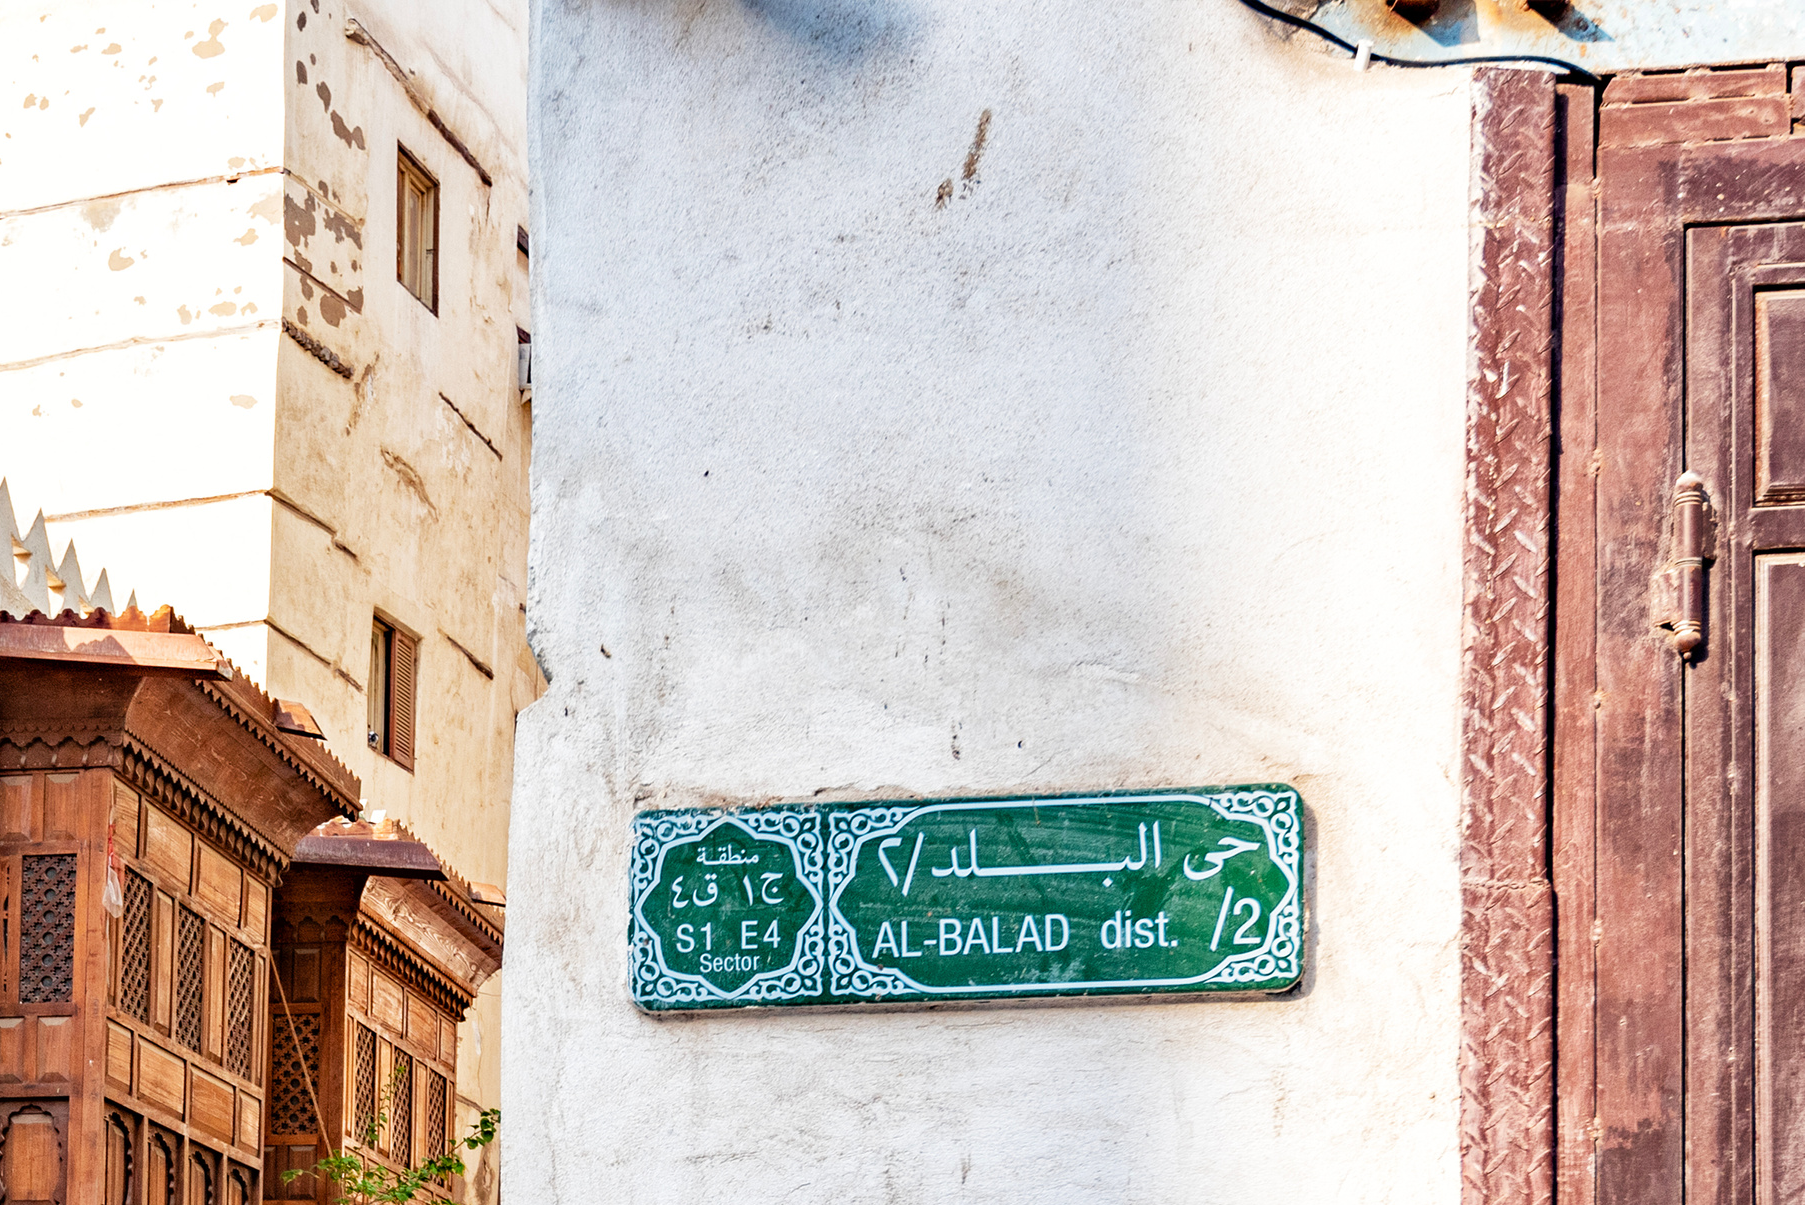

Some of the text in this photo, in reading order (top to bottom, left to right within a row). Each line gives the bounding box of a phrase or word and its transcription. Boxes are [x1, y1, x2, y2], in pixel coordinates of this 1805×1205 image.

[696, 844, 760, 866] منطقة
[676, 919, 781, 953] S1 E4
[872, 913, 1070, 959] AL-BALAD
[1100, 910, 1178, 949] dist.
[699, 953, 760, 973] Sector
